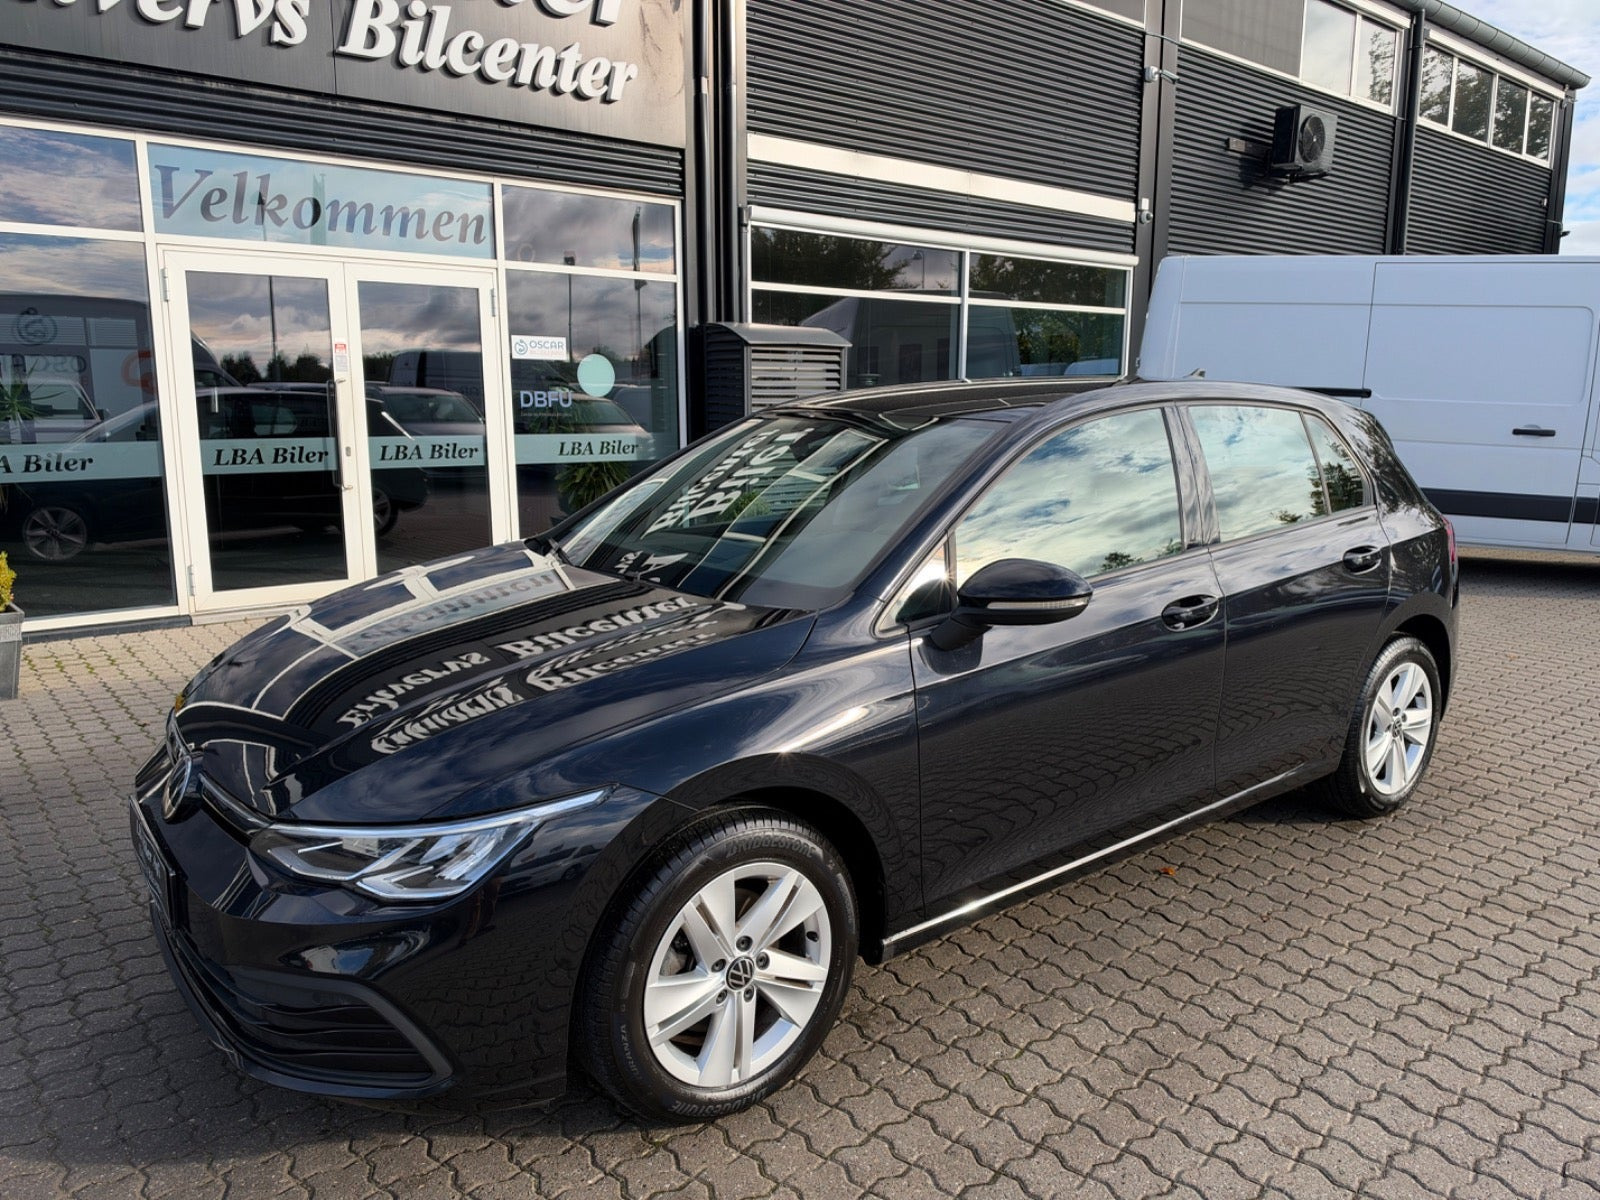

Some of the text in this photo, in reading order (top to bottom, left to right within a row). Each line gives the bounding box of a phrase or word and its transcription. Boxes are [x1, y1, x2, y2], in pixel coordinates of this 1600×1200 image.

[335, 0, 638, 101] Bilcenter
[154, 164, 486, 245] Velkommen
[529, 340, 565, 350] OSCAR
[520, 390, 573, 408] DBFU
[213, 446, 329, 466] LBA Biler
[379, 442, 479, 461] LBA Biler
[558, 439, 639, 456] LBA Biler
[22, 452, 94, 473] Biler
